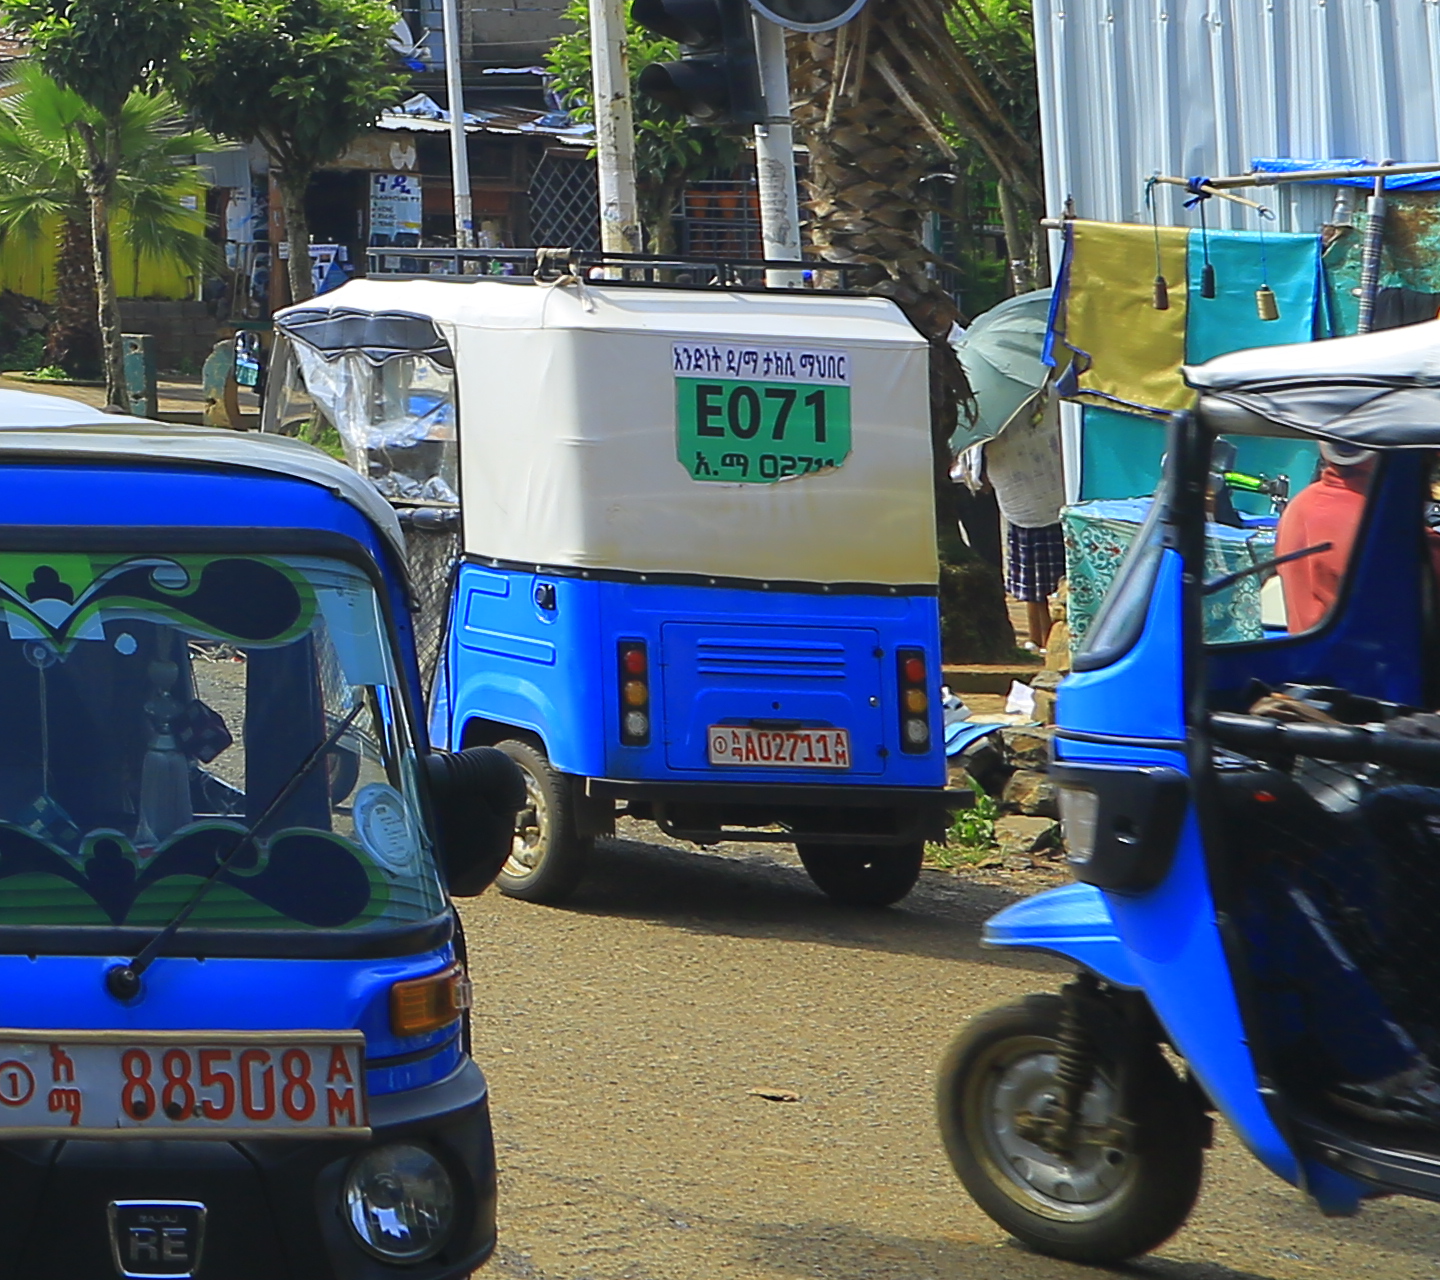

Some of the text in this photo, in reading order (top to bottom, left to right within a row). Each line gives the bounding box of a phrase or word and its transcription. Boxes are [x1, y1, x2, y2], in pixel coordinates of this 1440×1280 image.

[695, 384, 827, 443] E071
[745, 731, 832, 762] A02711
[121, 1047, 316, 1121] 88508
[128, 1227, 189, 1261] RE
